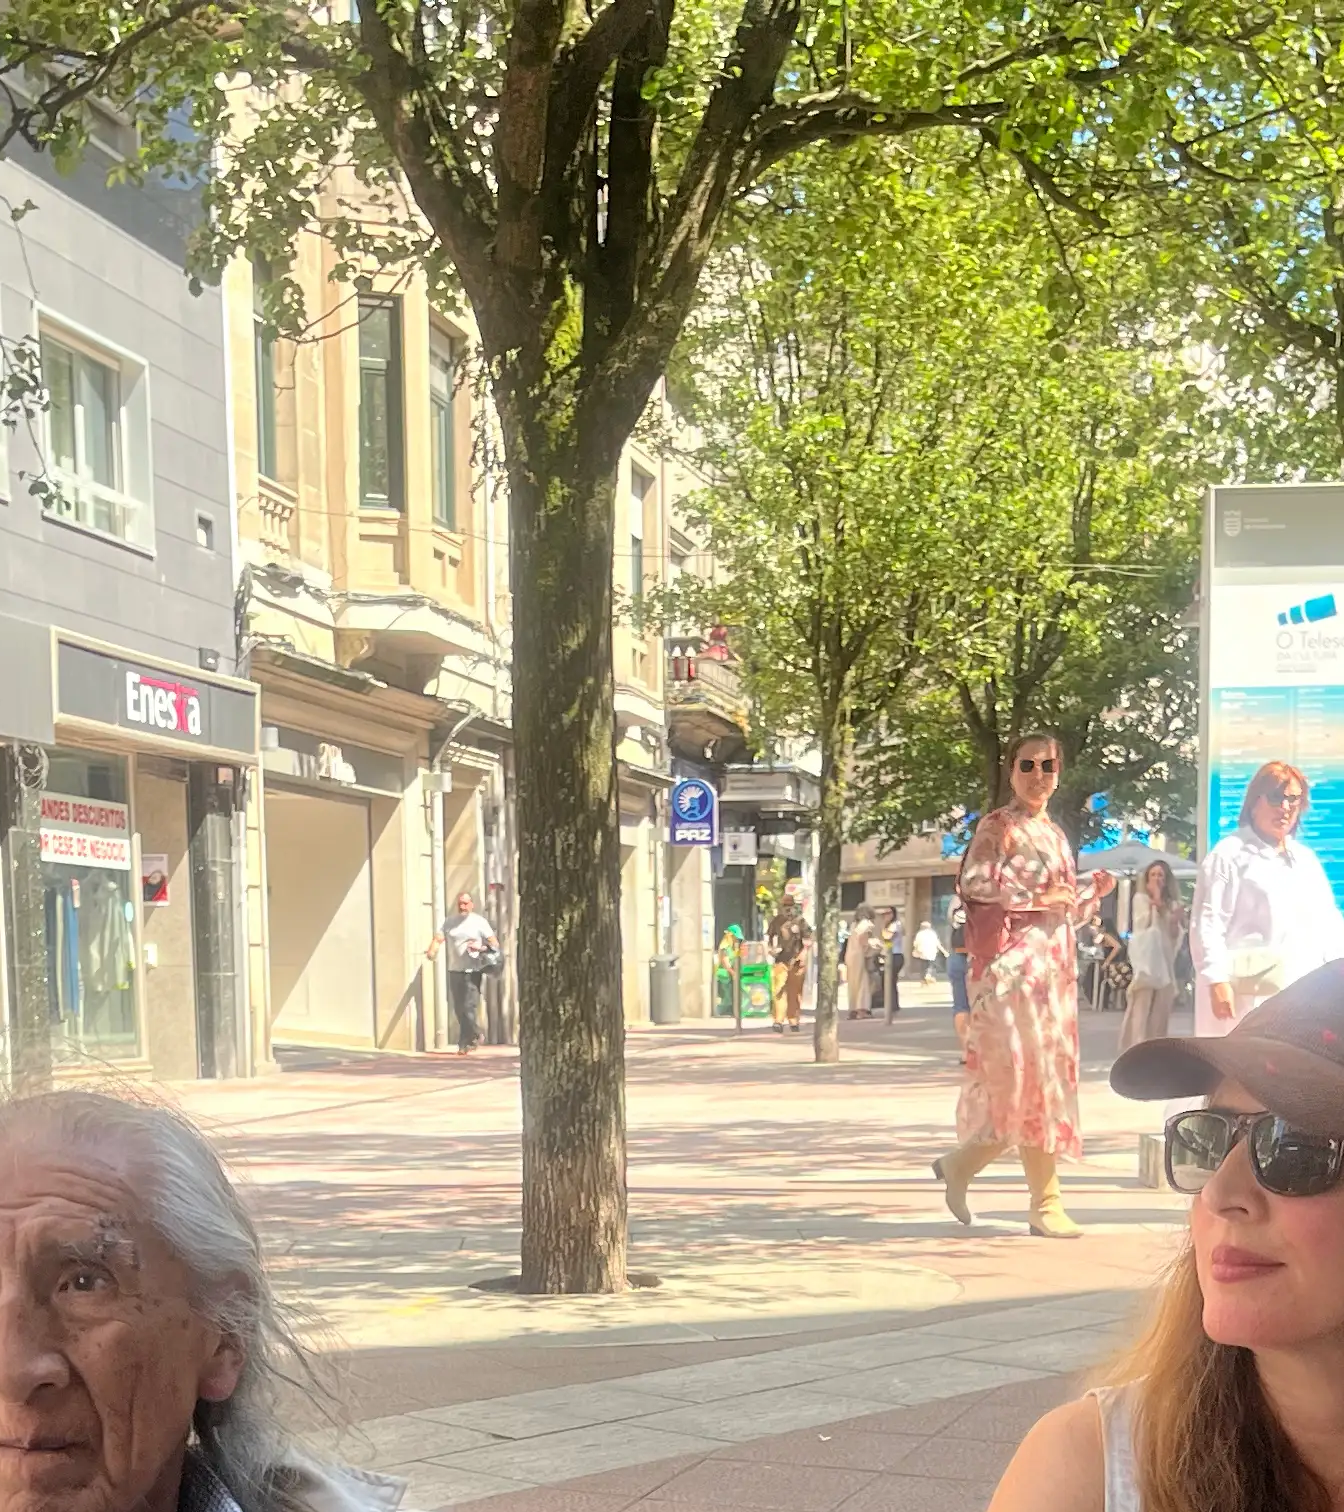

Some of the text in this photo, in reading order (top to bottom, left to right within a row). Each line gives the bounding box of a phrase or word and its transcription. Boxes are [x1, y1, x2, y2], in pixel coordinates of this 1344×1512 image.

[1276, 631, 1294, 650] O
[72, 803, 126, 830] DESCUENTOS
[675, 829, 712, 842] PAZ
